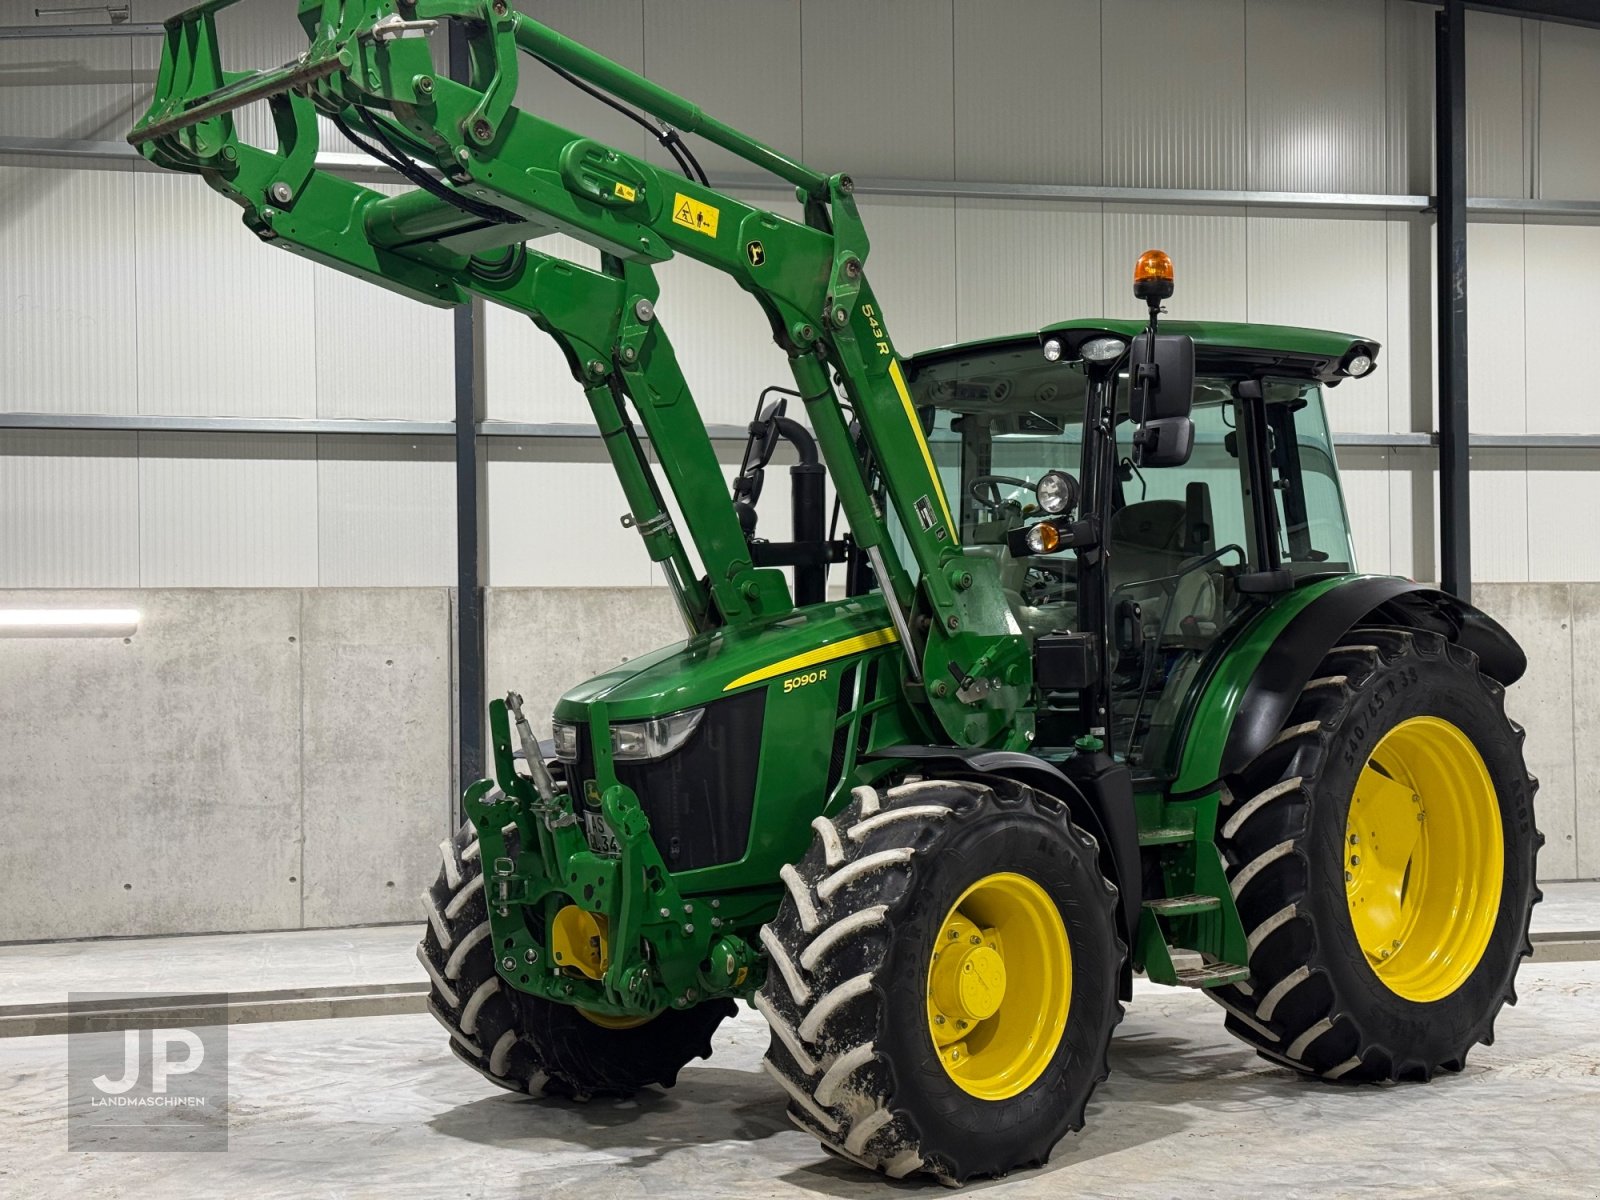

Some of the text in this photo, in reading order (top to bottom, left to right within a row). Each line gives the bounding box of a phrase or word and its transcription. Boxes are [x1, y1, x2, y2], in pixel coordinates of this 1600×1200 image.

[862, 304, 890, 355] 543 R
[783, 669, 827, 693] 5090 R
[591, 815, 605, 833] AS
[601, 835, 621, 853] 34
